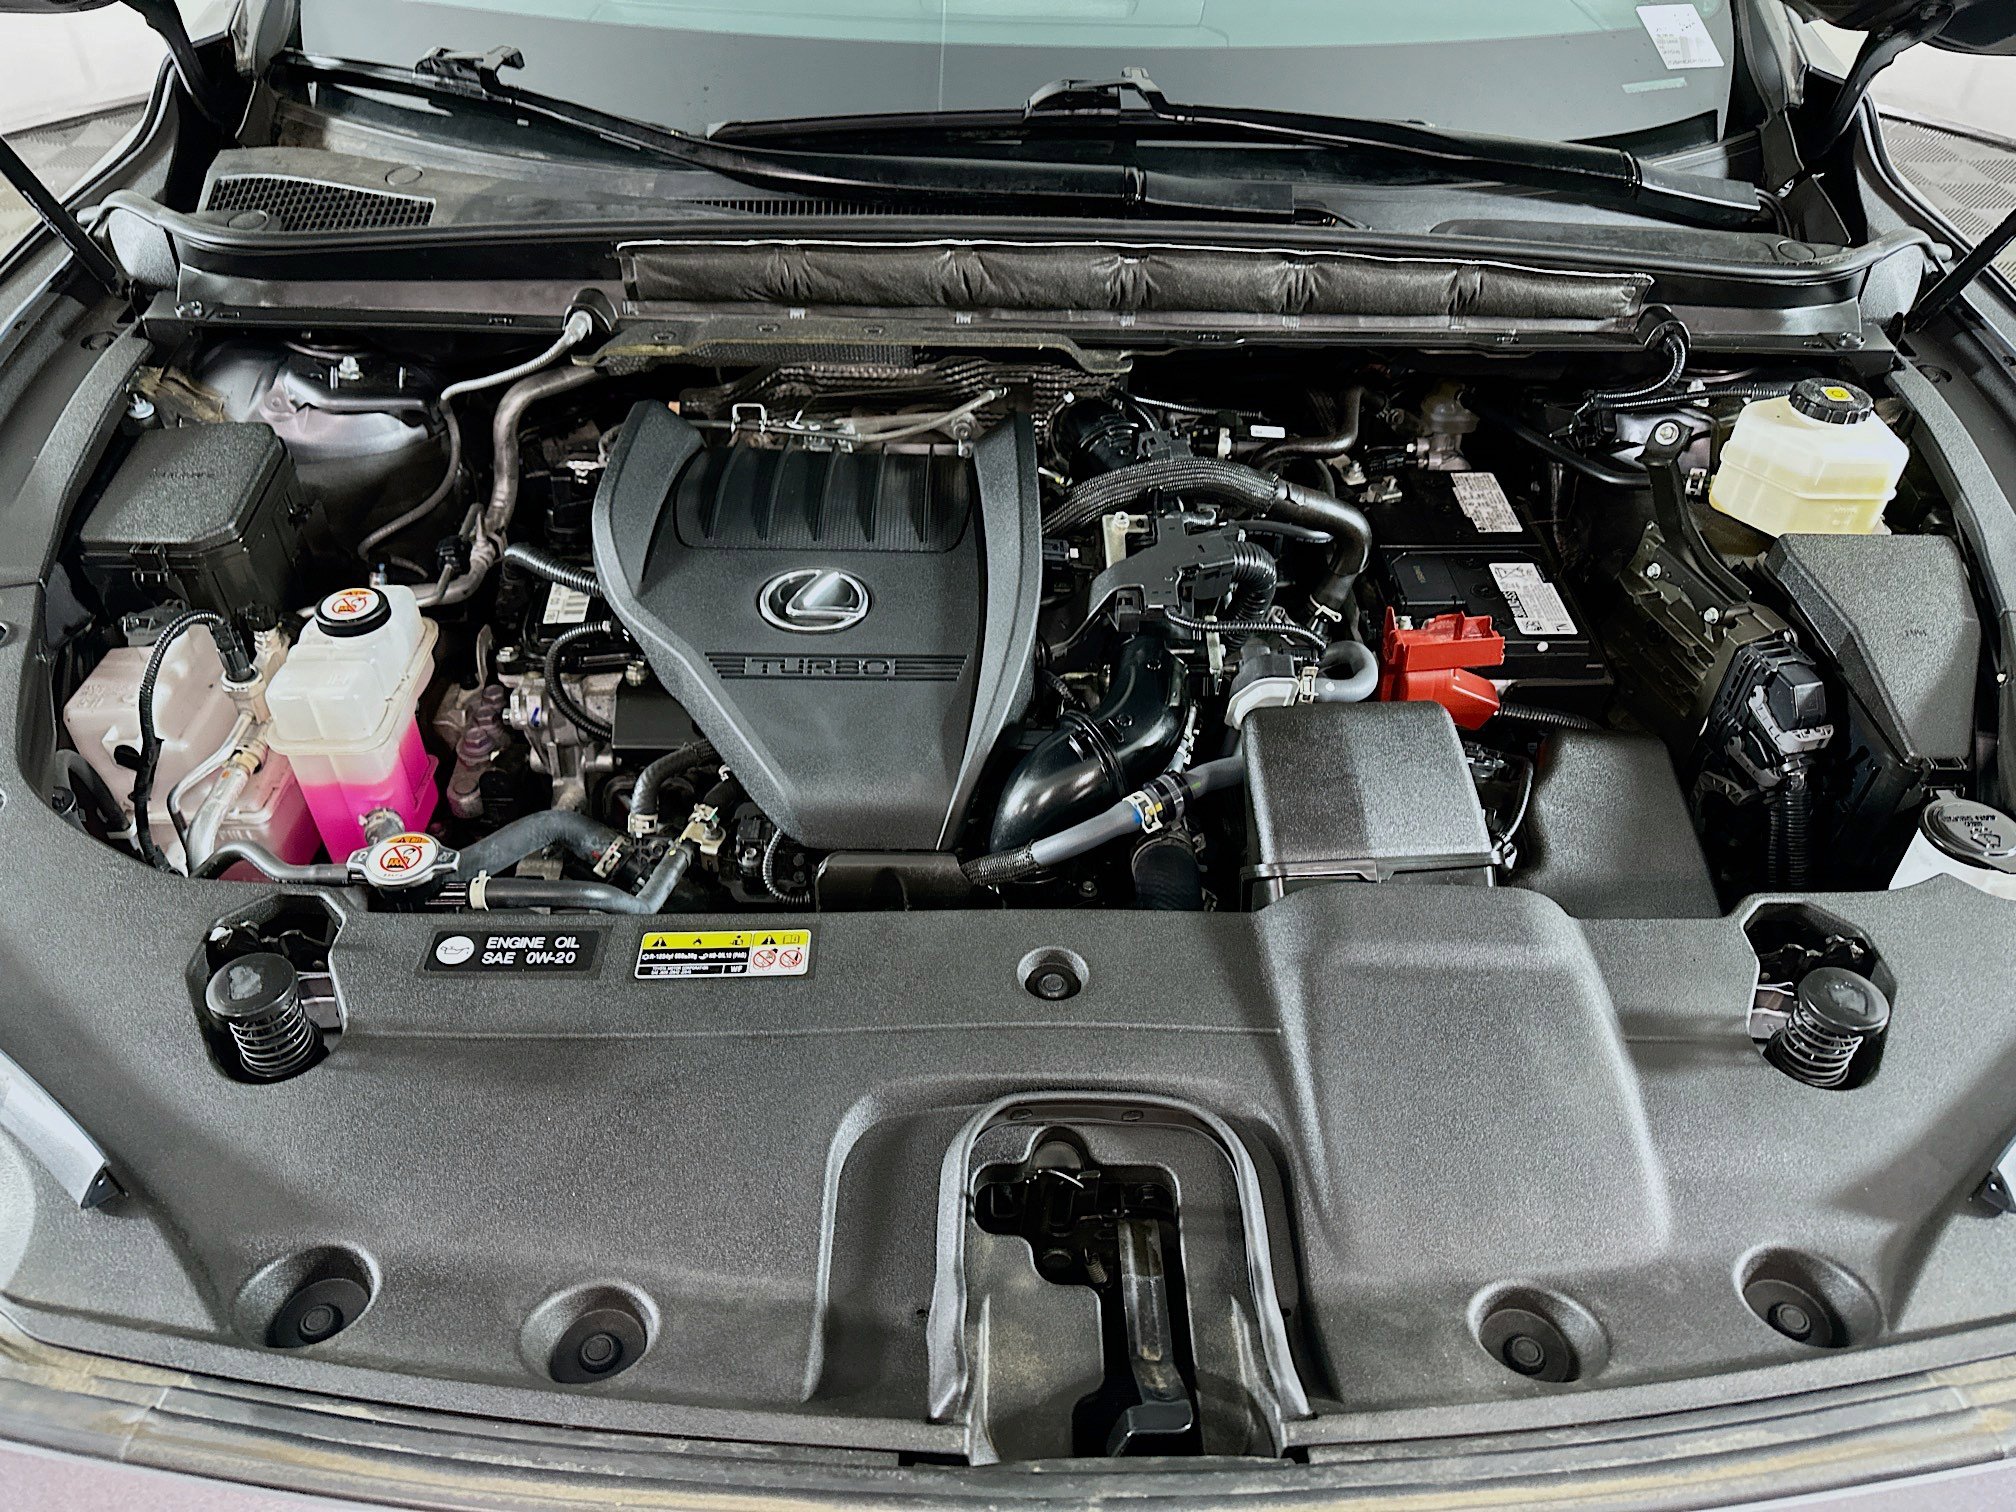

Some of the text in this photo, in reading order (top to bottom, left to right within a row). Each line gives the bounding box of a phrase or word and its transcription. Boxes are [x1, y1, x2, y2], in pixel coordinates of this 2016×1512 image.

[750, 657, 891, 675] TURBO
[486, 936, 580, 949] ENGINE OIL
[481, 951, 576, 965] SAE 0W-20
